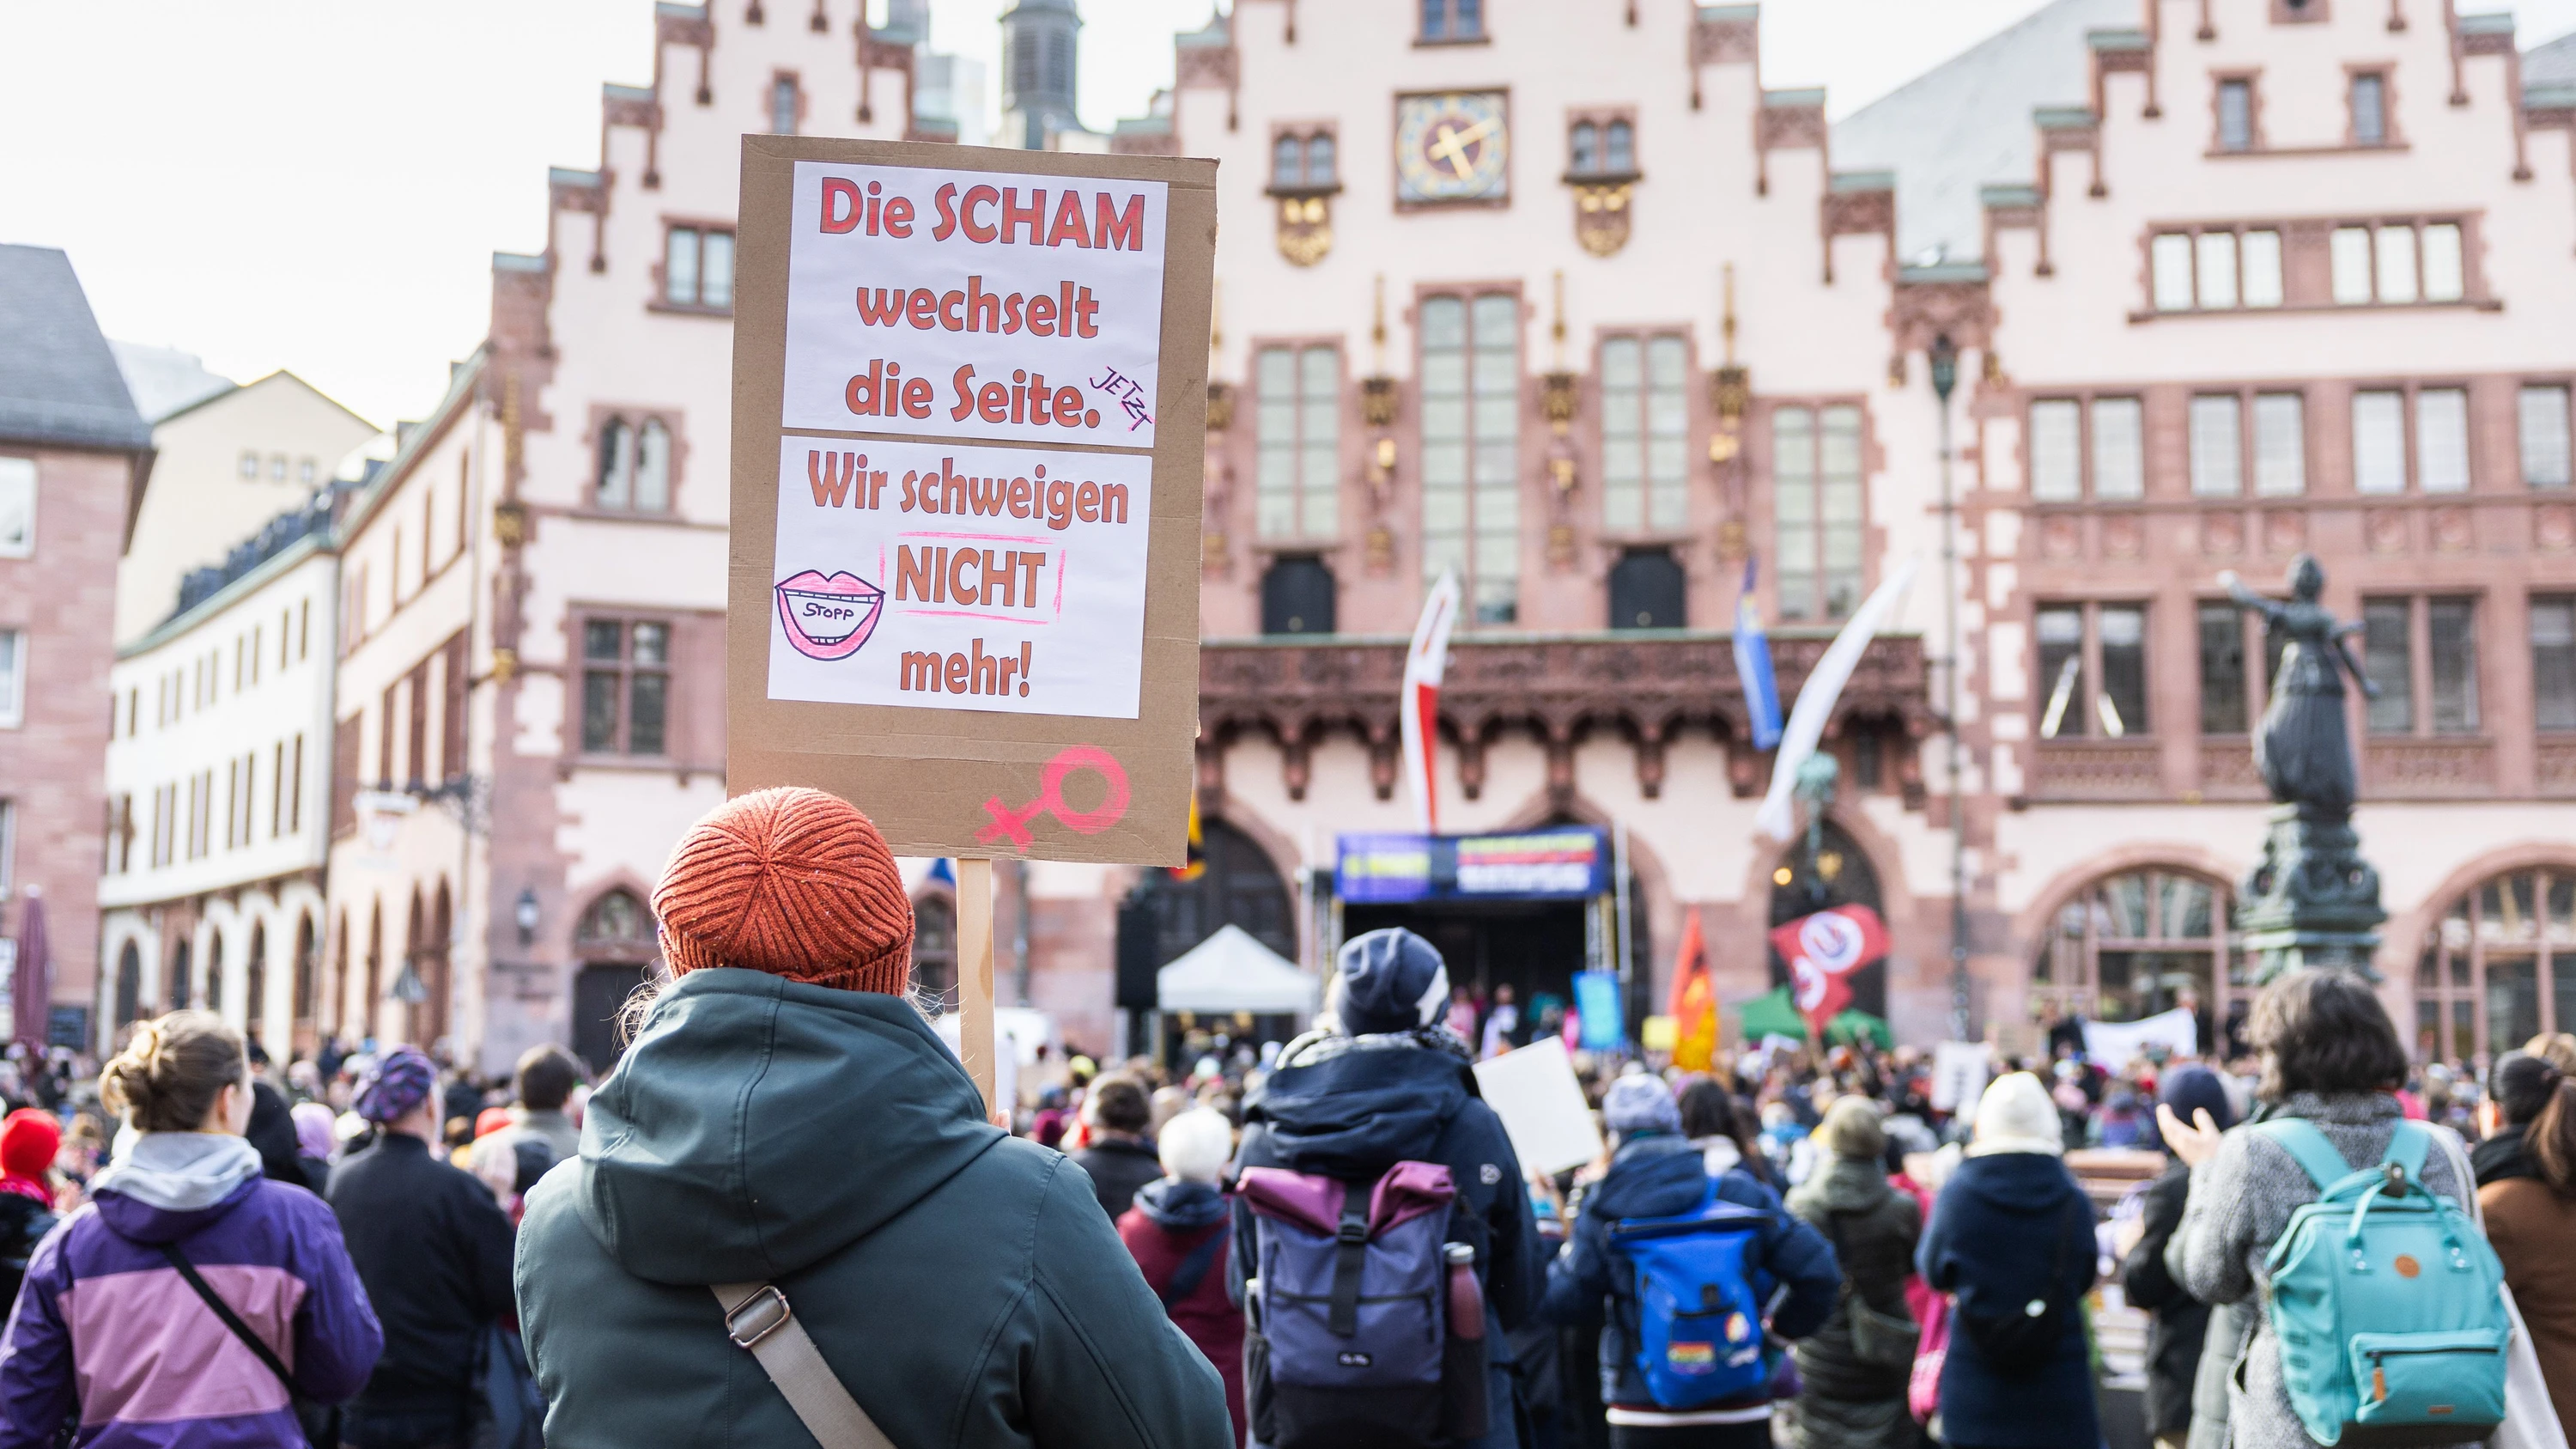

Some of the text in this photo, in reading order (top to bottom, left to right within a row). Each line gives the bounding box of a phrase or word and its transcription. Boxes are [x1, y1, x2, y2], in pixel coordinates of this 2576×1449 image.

[819, 177, 1145, 252] Die SCHAM
[856, 275, 1100, 339] wechselt
[845, 358, 1102, 429] die Seite.
[1089, 366, 1152, 431] JETZT
[807, 450, 1129, 531] Wir schweigen
[895, 544, 1047, 608] NICHT
[802, 602, 854, 621] STOPP
[900, 637, 1032, 698] mehr!
